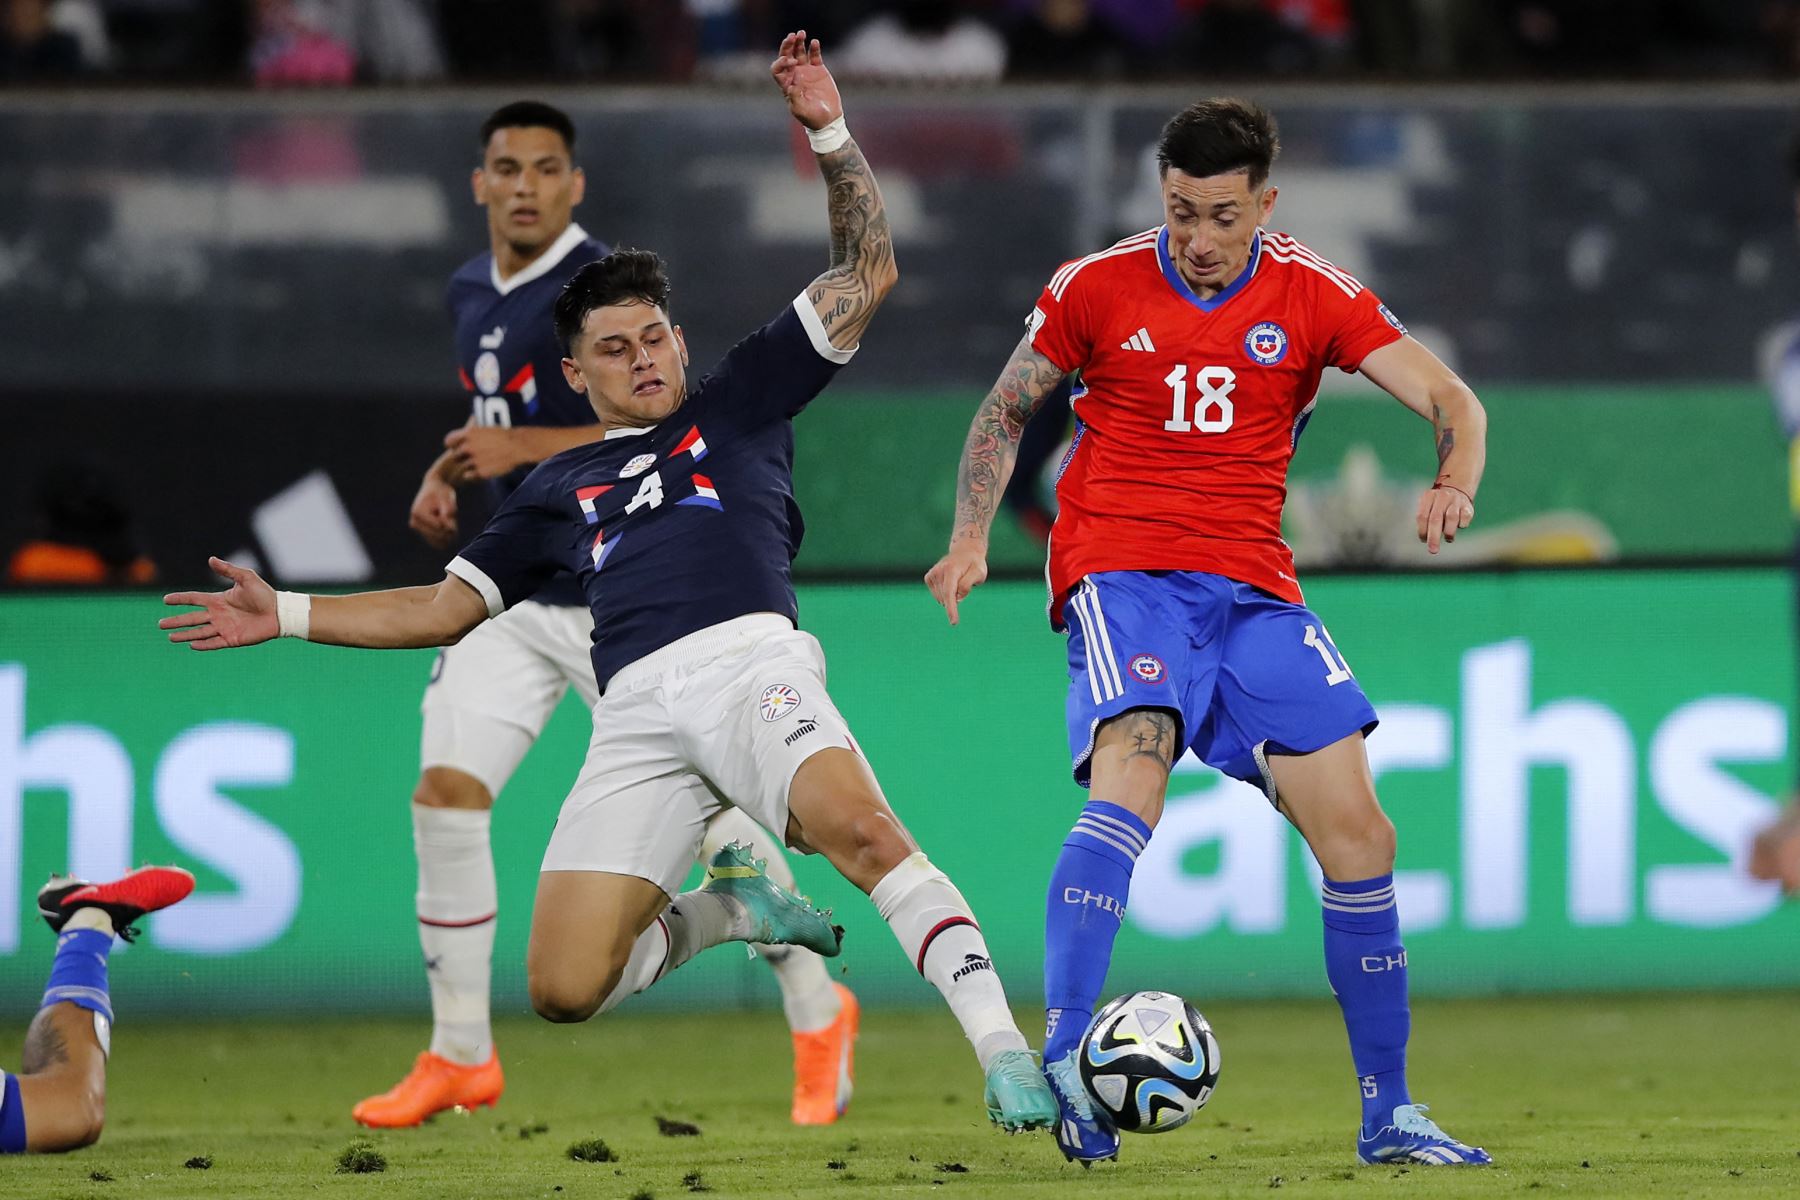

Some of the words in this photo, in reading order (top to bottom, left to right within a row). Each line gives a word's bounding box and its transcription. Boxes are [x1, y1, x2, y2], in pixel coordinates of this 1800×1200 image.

[1163, 364, 1236, 433] 18
[624, 470, 664, 515] 4
[1303, 623, 1355, 687] 1
[784, 723, 816, 746] PUMA
